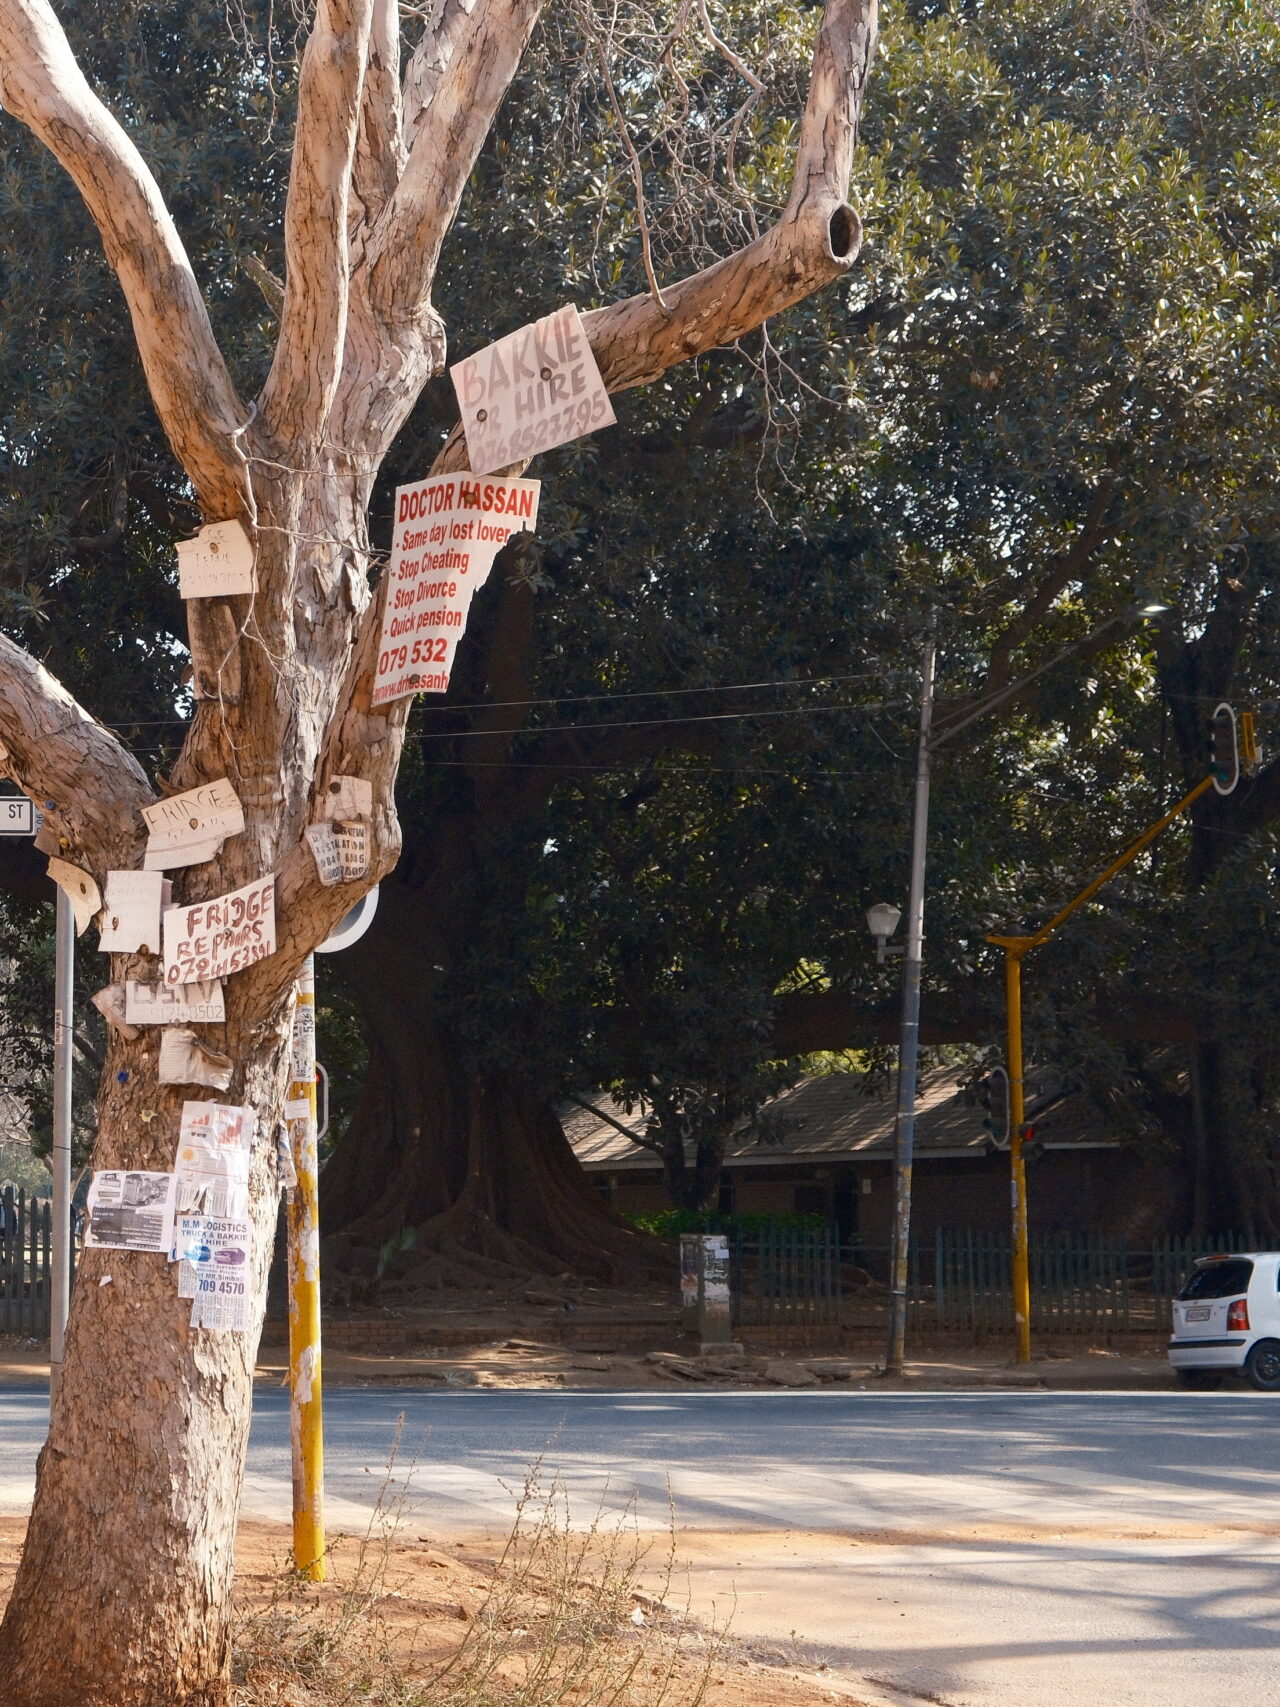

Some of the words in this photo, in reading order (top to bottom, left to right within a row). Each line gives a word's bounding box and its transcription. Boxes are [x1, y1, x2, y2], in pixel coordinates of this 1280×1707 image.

[463, 312, 582, 409] BAKKIE
[514, 362, 588, 421] HIRE
[399, 482, 455, 523] DOCTOR
[457, 480, 534, 518] HASSAN
[402, 530, 427, 552] Same
[429, 521, 448, 546] day
[449, 518, 474, 540] lost
[477, 519, 511, 543] lover
[398, 559, 419, 581] Stop
[421, 548, 470, 575] Cheating
[394, 589, 415, 610] Stop
[417, 580, 457, 603] Divorce
[390, 612, 416, 637] Quick
[416, 605, 462, 634] pension
[379, 645, 408, 675] 079
[411, 638, 448, 664] 532
[8, 804, 24, 819] ST
[217, 1233, 248, 1241] BAKKIE
[199, 1280, 216, 1292] 709
[219, 1282, 245, 1295] 4570
